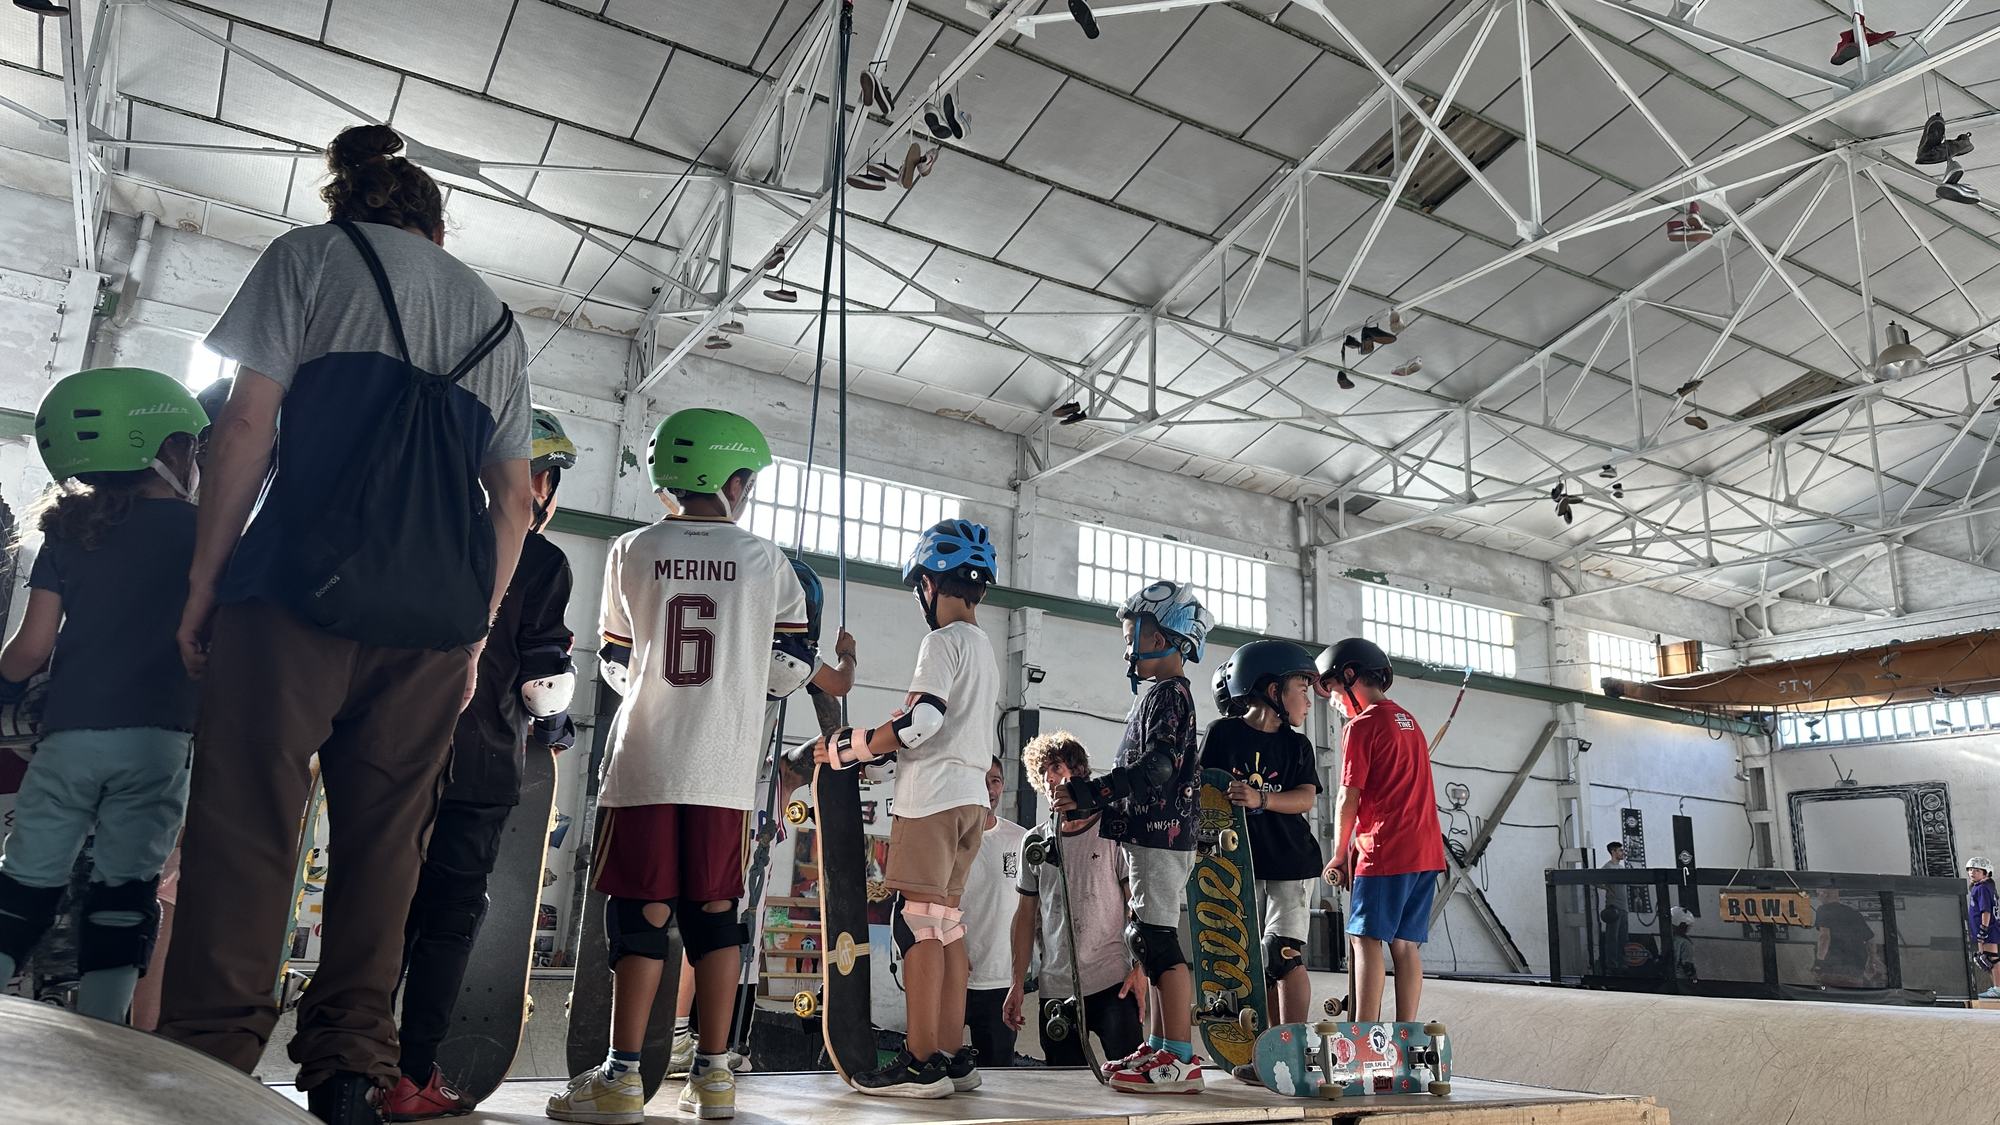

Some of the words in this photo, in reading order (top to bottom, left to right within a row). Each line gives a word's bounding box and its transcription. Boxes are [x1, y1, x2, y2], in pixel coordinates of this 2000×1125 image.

[128, 403, 191, 416] miller
[708, 442, 758, 454] miller
[654, 559, 737, 581] MERINO
[662, 593, 717, 688] 6
[1727, 898, 1798, 918] BOWL
